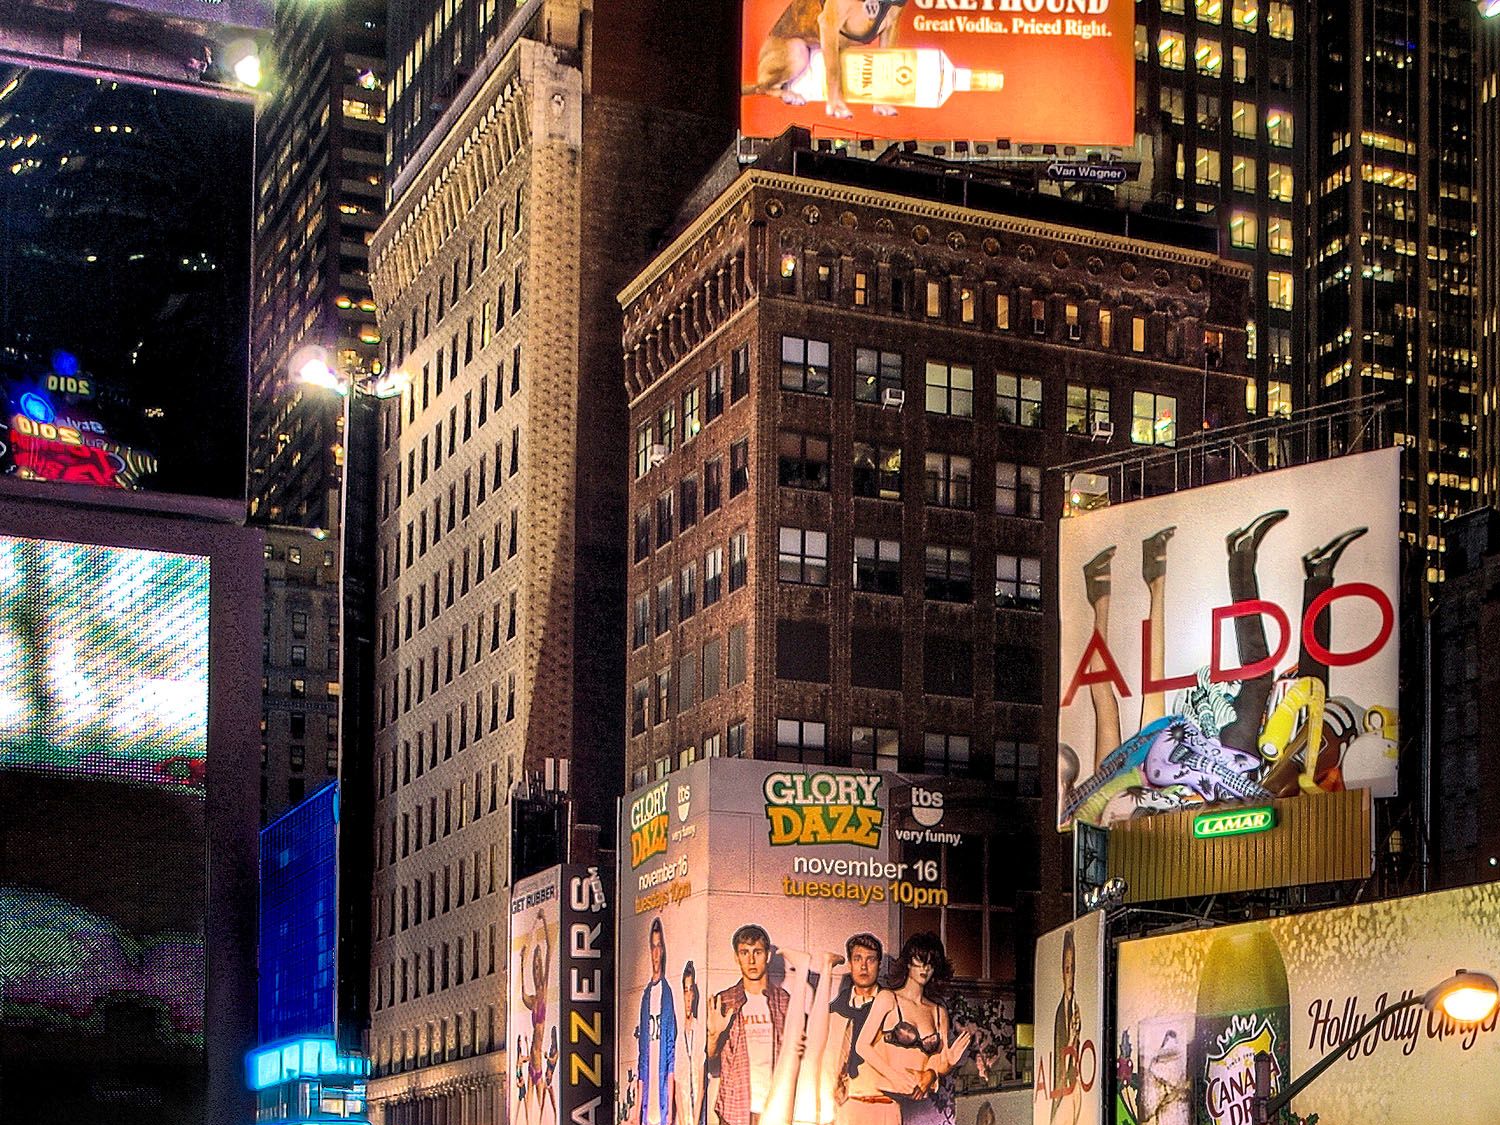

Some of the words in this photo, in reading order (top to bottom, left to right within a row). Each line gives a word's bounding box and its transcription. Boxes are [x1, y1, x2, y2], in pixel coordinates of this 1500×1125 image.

[913, 16, 955, 32] Great
[956, 17, 1008, 33] Vodka.
[1012, 18, 1061, 36] Priced
[1064, 22, 1112, 39] Right.
[1061, 583, 1394, 707] ALDO
[631, 780, 670, 830] GLORY
[765, 772, 882, 805] GLORY
[911, 786, 944, 808] tbs
[895, 829, 923, 843] very
[925, 829, 963, 846] funny.
[1201, 813, 1274, 835] LAMAR
[638, 860, 677, 892] november
[677, 854, 689, 879] 16
[793, 855, 904, 880] november
[912, 859, 938, 882] 16
[782, 879, 885, 906] tuesdays
[888, 881, 949, 907] 10pm
[1308, 997, 1367, 1060] Holly
[1034, 1037, 1097, 1104] ALDO
